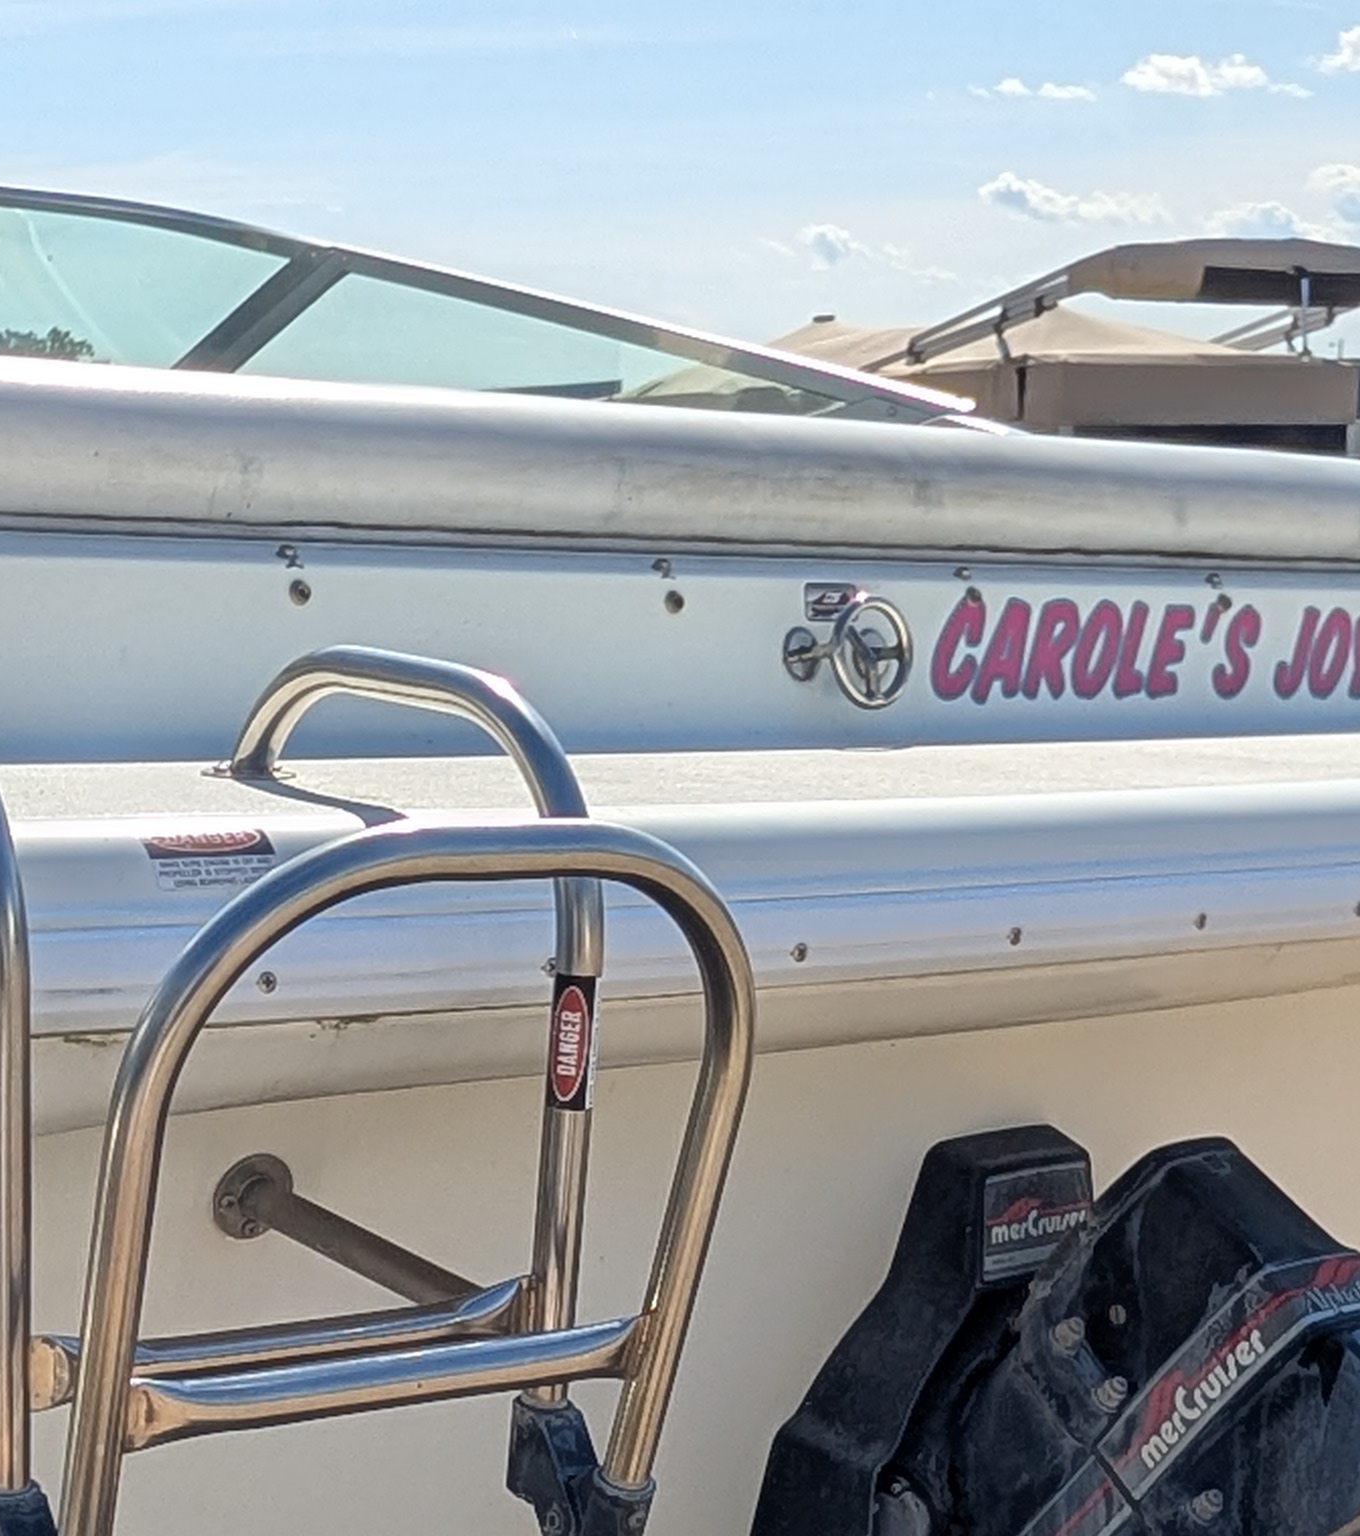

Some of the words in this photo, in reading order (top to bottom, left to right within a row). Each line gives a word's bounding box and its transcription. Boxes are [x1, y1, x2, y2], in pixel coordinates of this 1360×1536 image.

[929, 597, 1263, 705] CAROLE'S
[556, 1010, 583, 1077] DANGER
[1140, 1328, 1266, 1470] merCruiser
